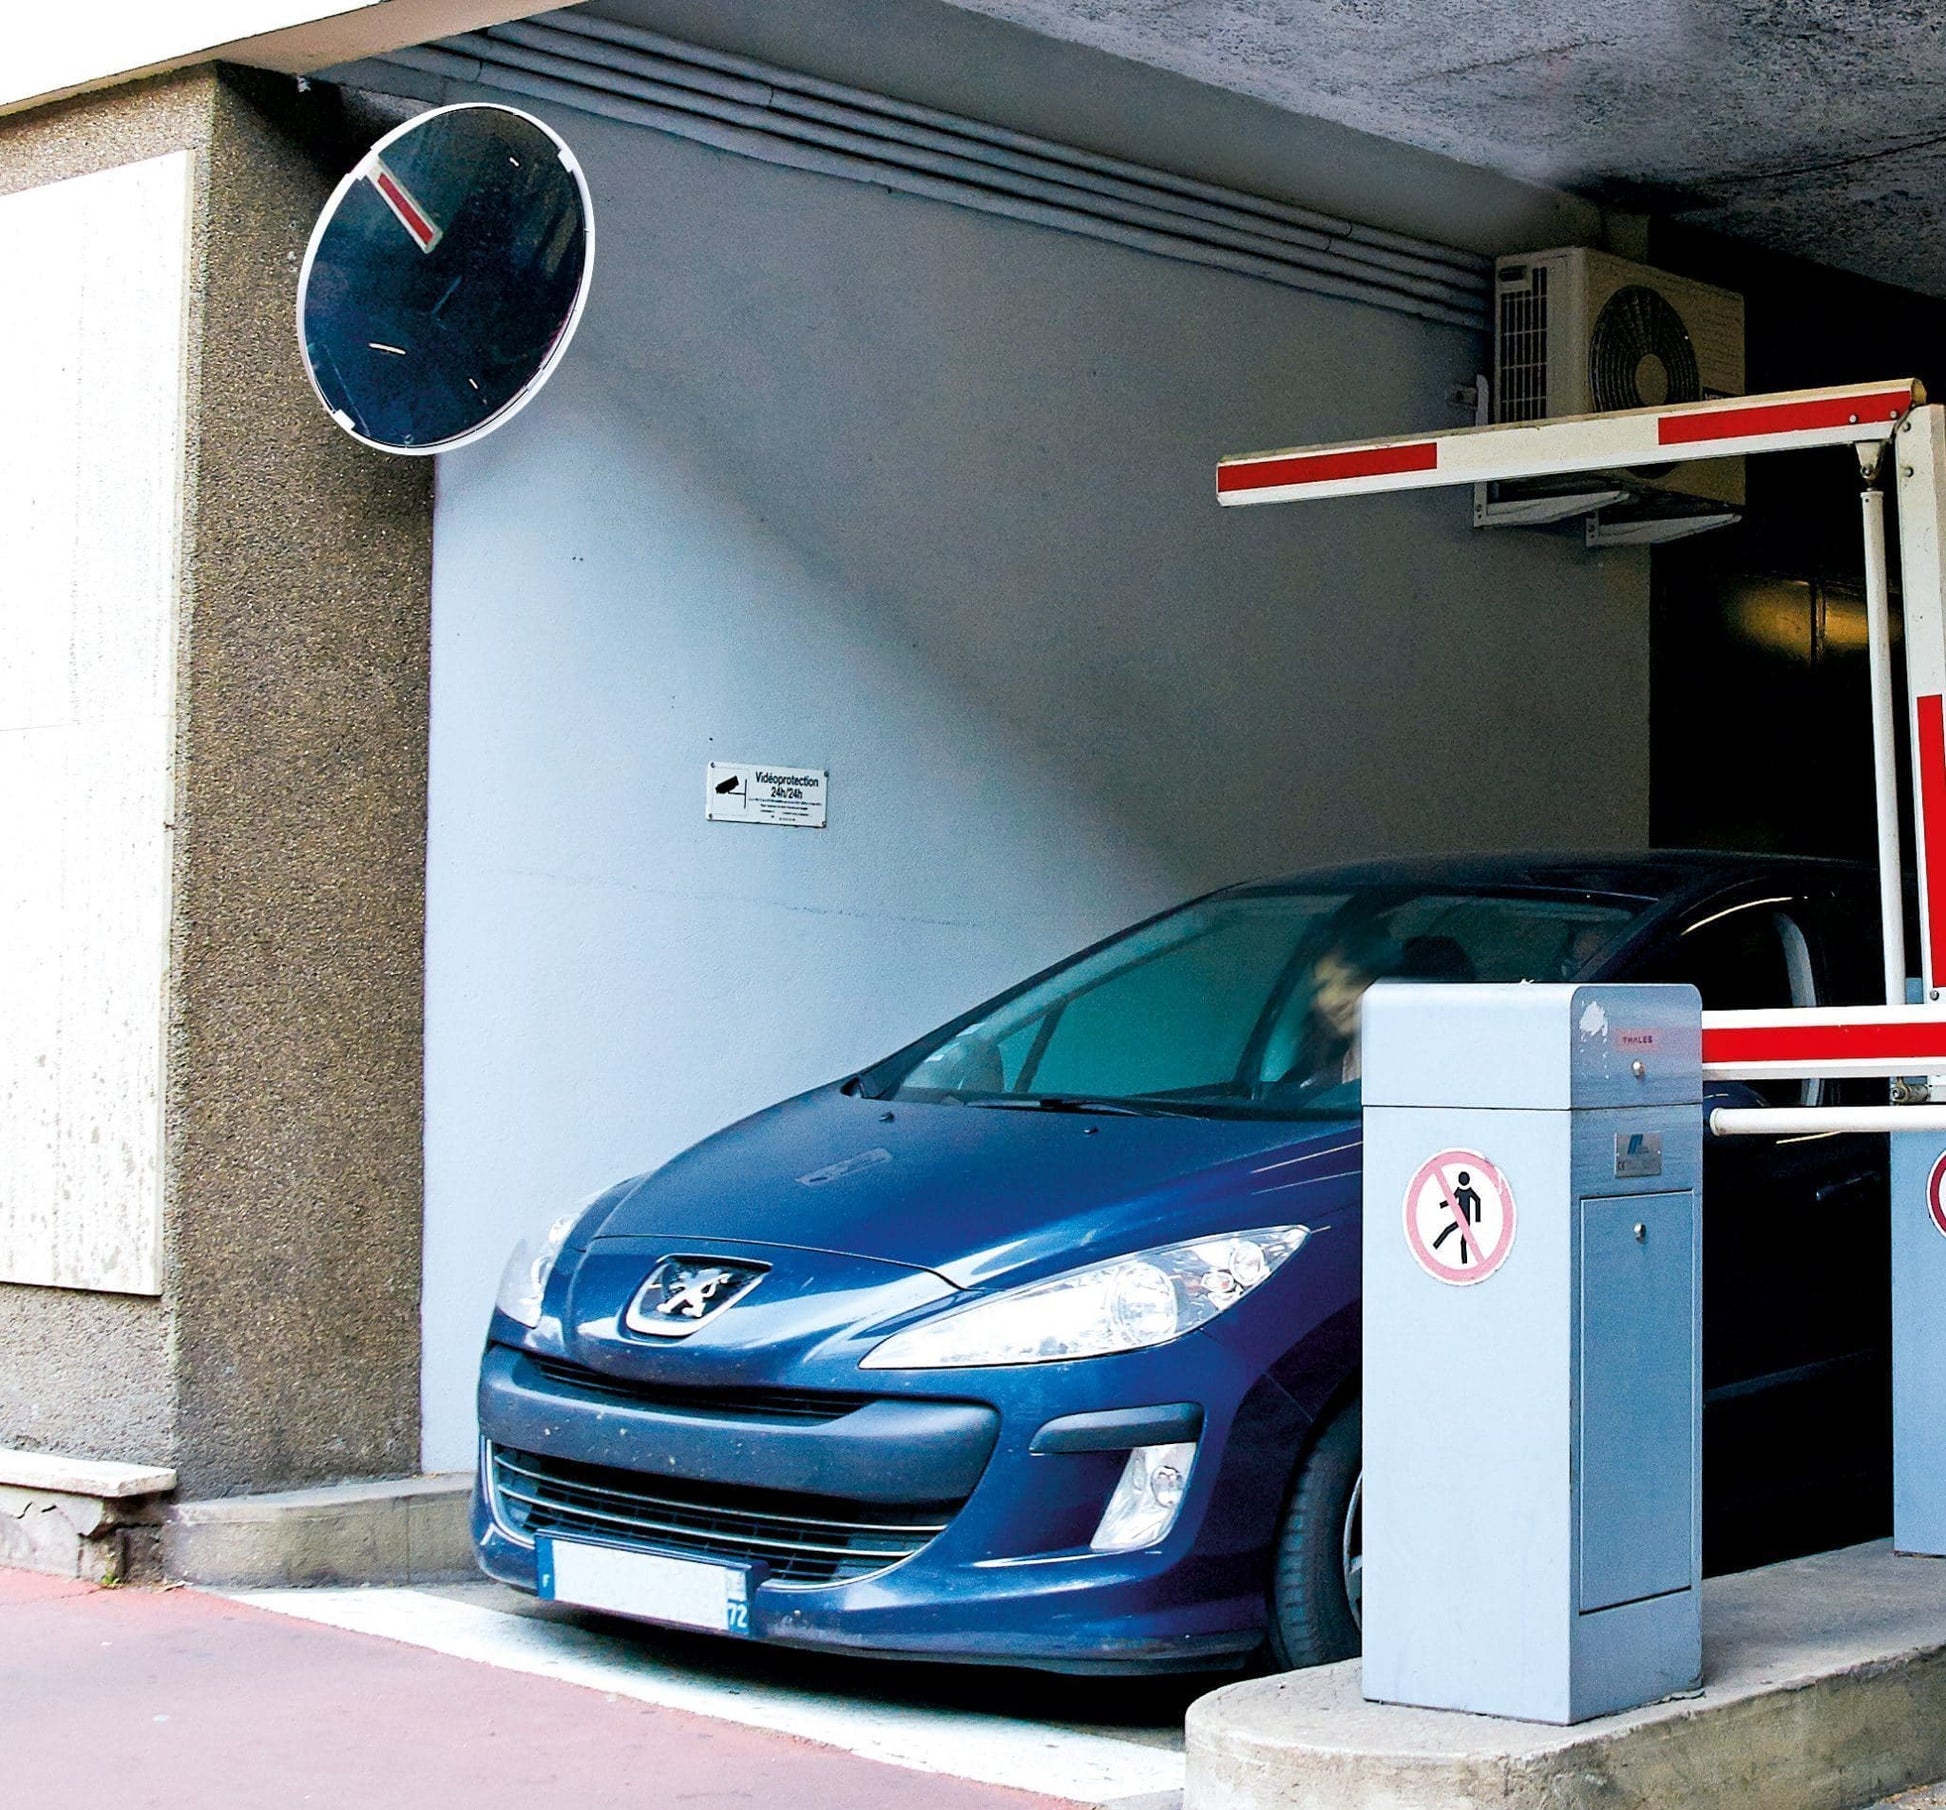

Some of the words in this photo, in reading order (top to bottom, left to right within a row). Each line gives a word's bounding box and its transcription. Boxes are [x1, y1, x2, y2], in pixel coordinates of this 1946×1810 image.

[755, 771, 819, 787] Vidéoprotection
[770, 786, 803, 799] 24h/24h
[727, 1602, 748, 1628] 72
